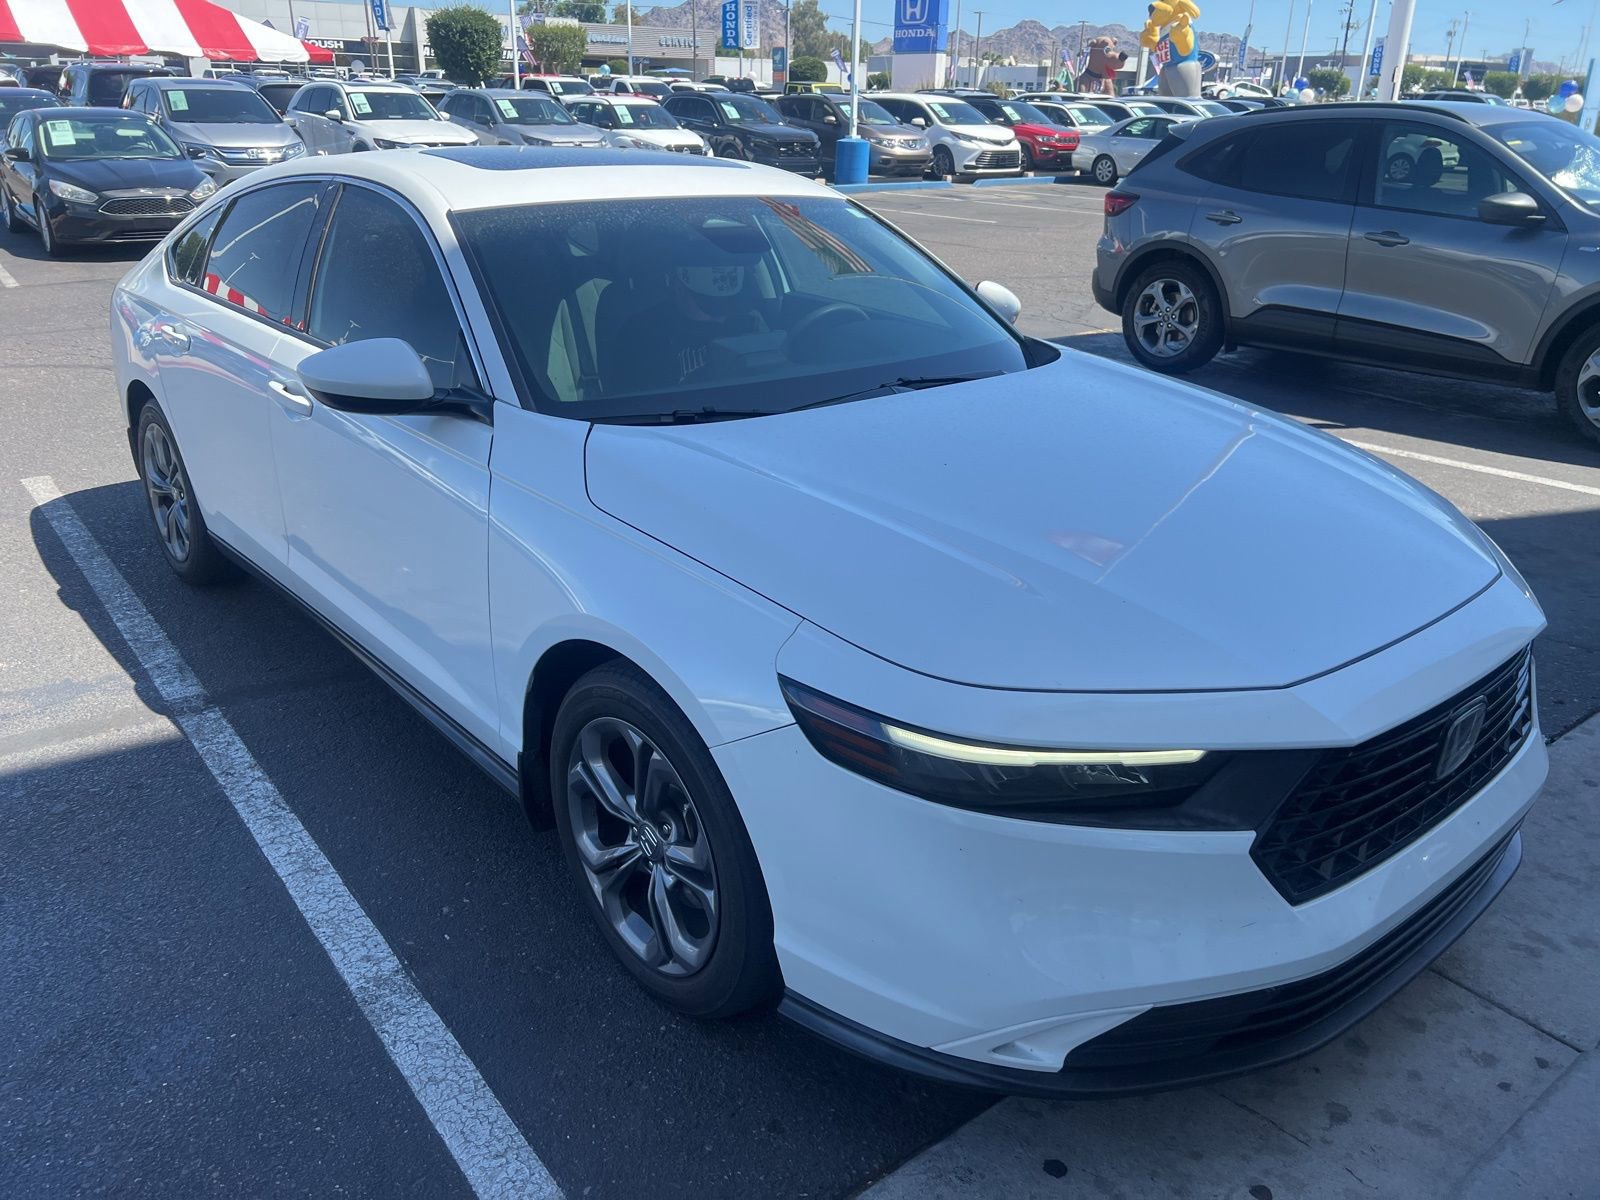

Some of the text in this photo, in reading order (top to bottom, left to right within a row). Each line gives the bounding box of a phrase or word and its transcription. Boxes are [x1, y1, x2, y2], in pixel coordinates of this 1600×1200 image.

[726, 4, 737, 46] HONDA
[744, 5, 753, 46] Certified
[895, 28, 933, 38] HONDA
[1372, 46, 1383, 74] HONDA
